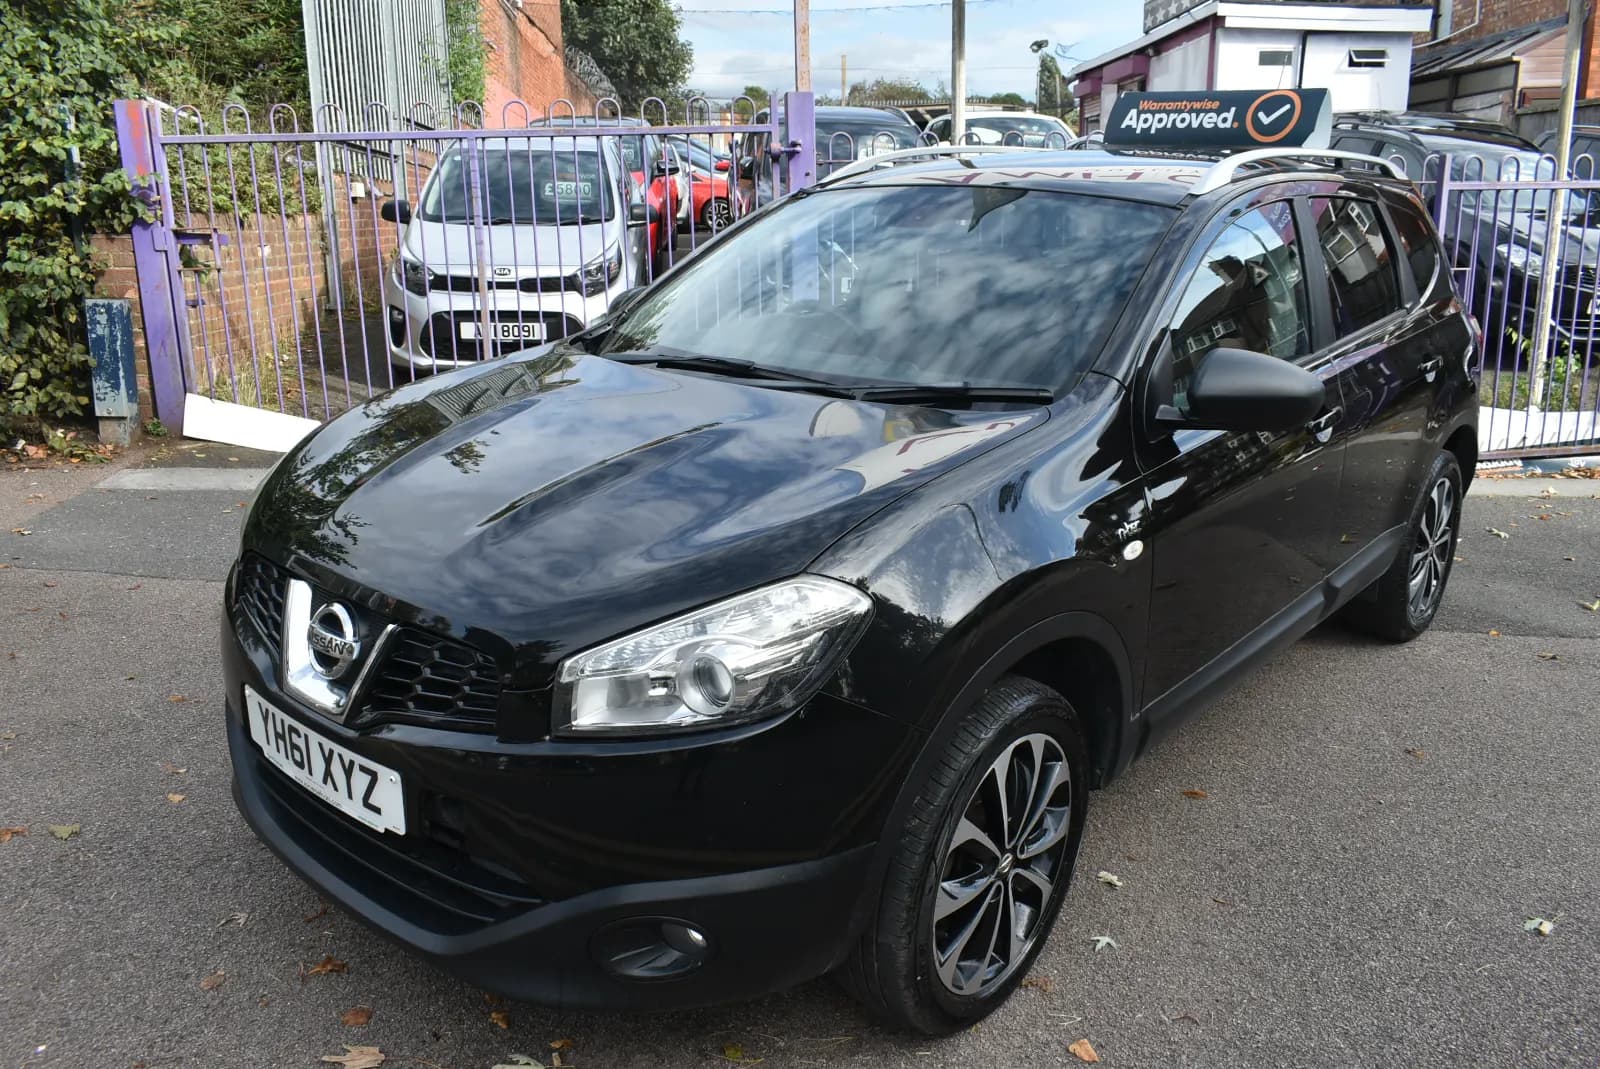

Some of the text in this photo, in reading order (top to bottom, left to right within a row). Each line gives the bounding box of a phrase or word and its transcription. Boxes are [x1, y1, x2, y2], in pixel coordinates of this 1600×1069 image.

[1139, 99, 1220, 111] Warrantywise
[1120, 107, 1239, 134] Approved.
[501, 325, 535, 338] 8091
[258, 701, 314, 777] YH61
[318, 741, 382, 816] XYZ
